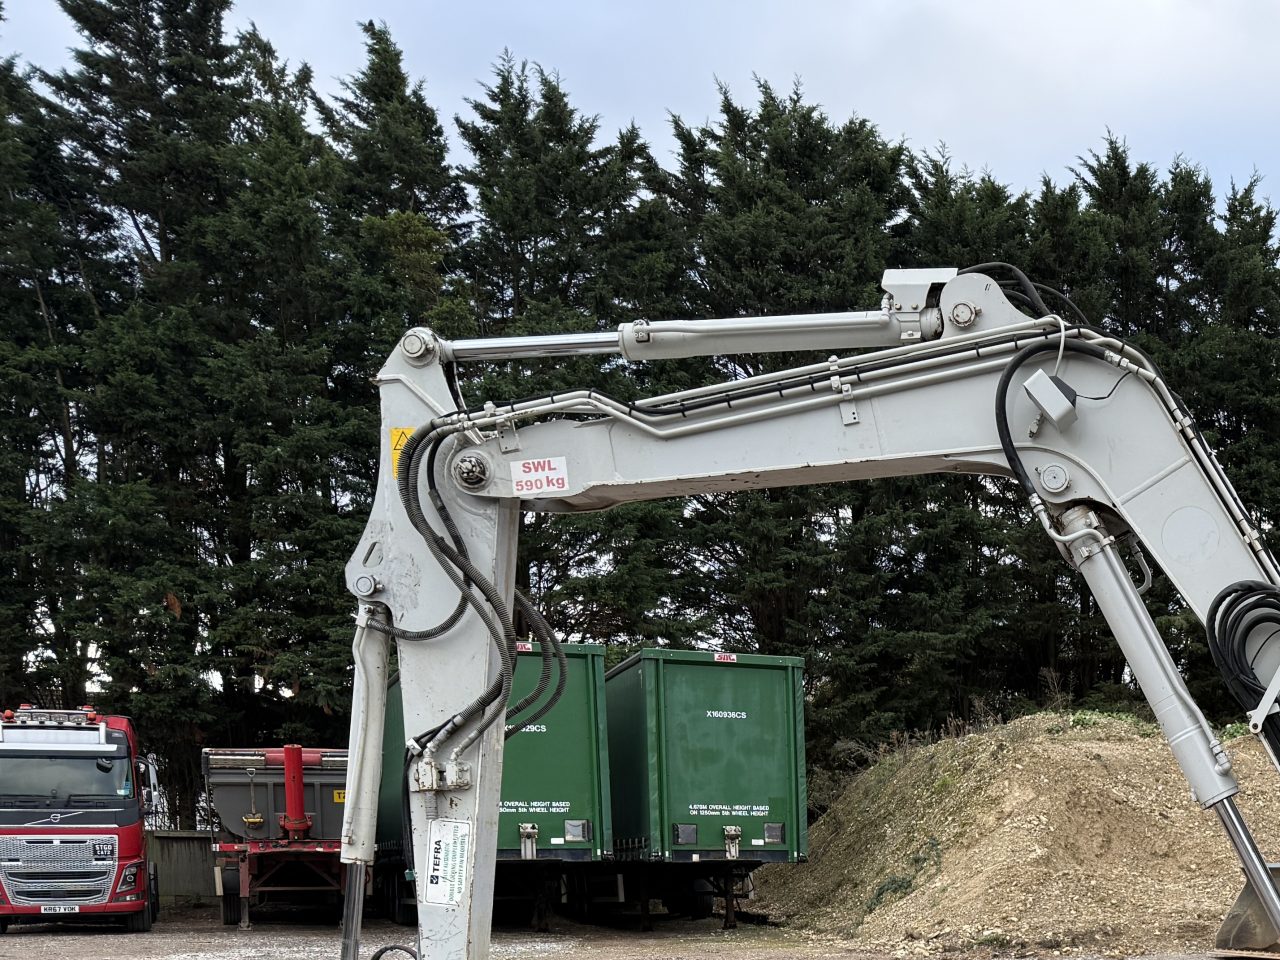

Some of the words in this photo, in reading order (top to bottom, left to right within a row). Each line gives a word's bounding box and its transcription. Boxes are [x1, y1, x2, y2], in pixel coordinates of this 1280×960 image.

[522, 460, 557, 474] SWL
[515, 478, 544, 491] 590
[545, 475, 566, 489] kg
[432, 840, 441, 873] TEFRA
